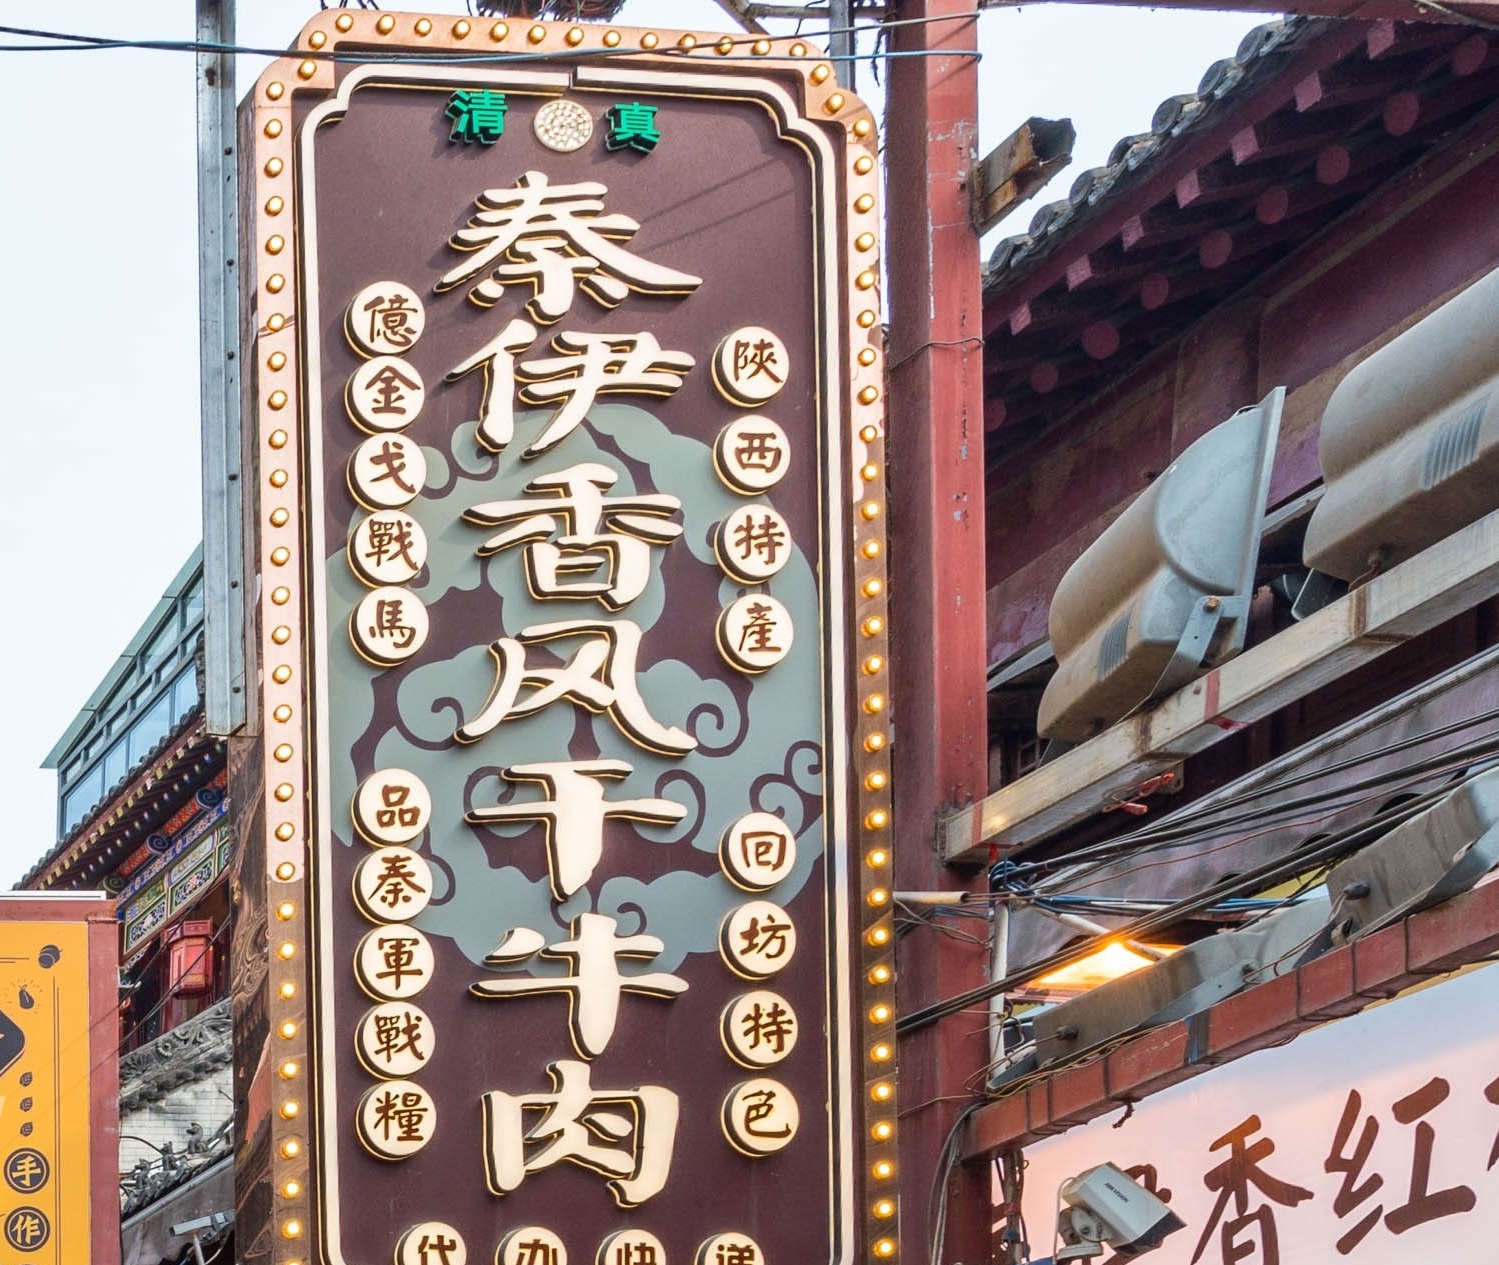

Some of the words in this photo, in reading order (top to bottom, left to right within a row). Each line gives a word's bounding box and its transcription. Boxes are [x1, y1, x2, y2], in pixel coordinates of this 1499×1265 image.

[449, 88, 661, 152] 清真
[434, 170, 703, 1208] 秦伊香风干牛肉
[737, 830, 793, 1139] 回坊特色
